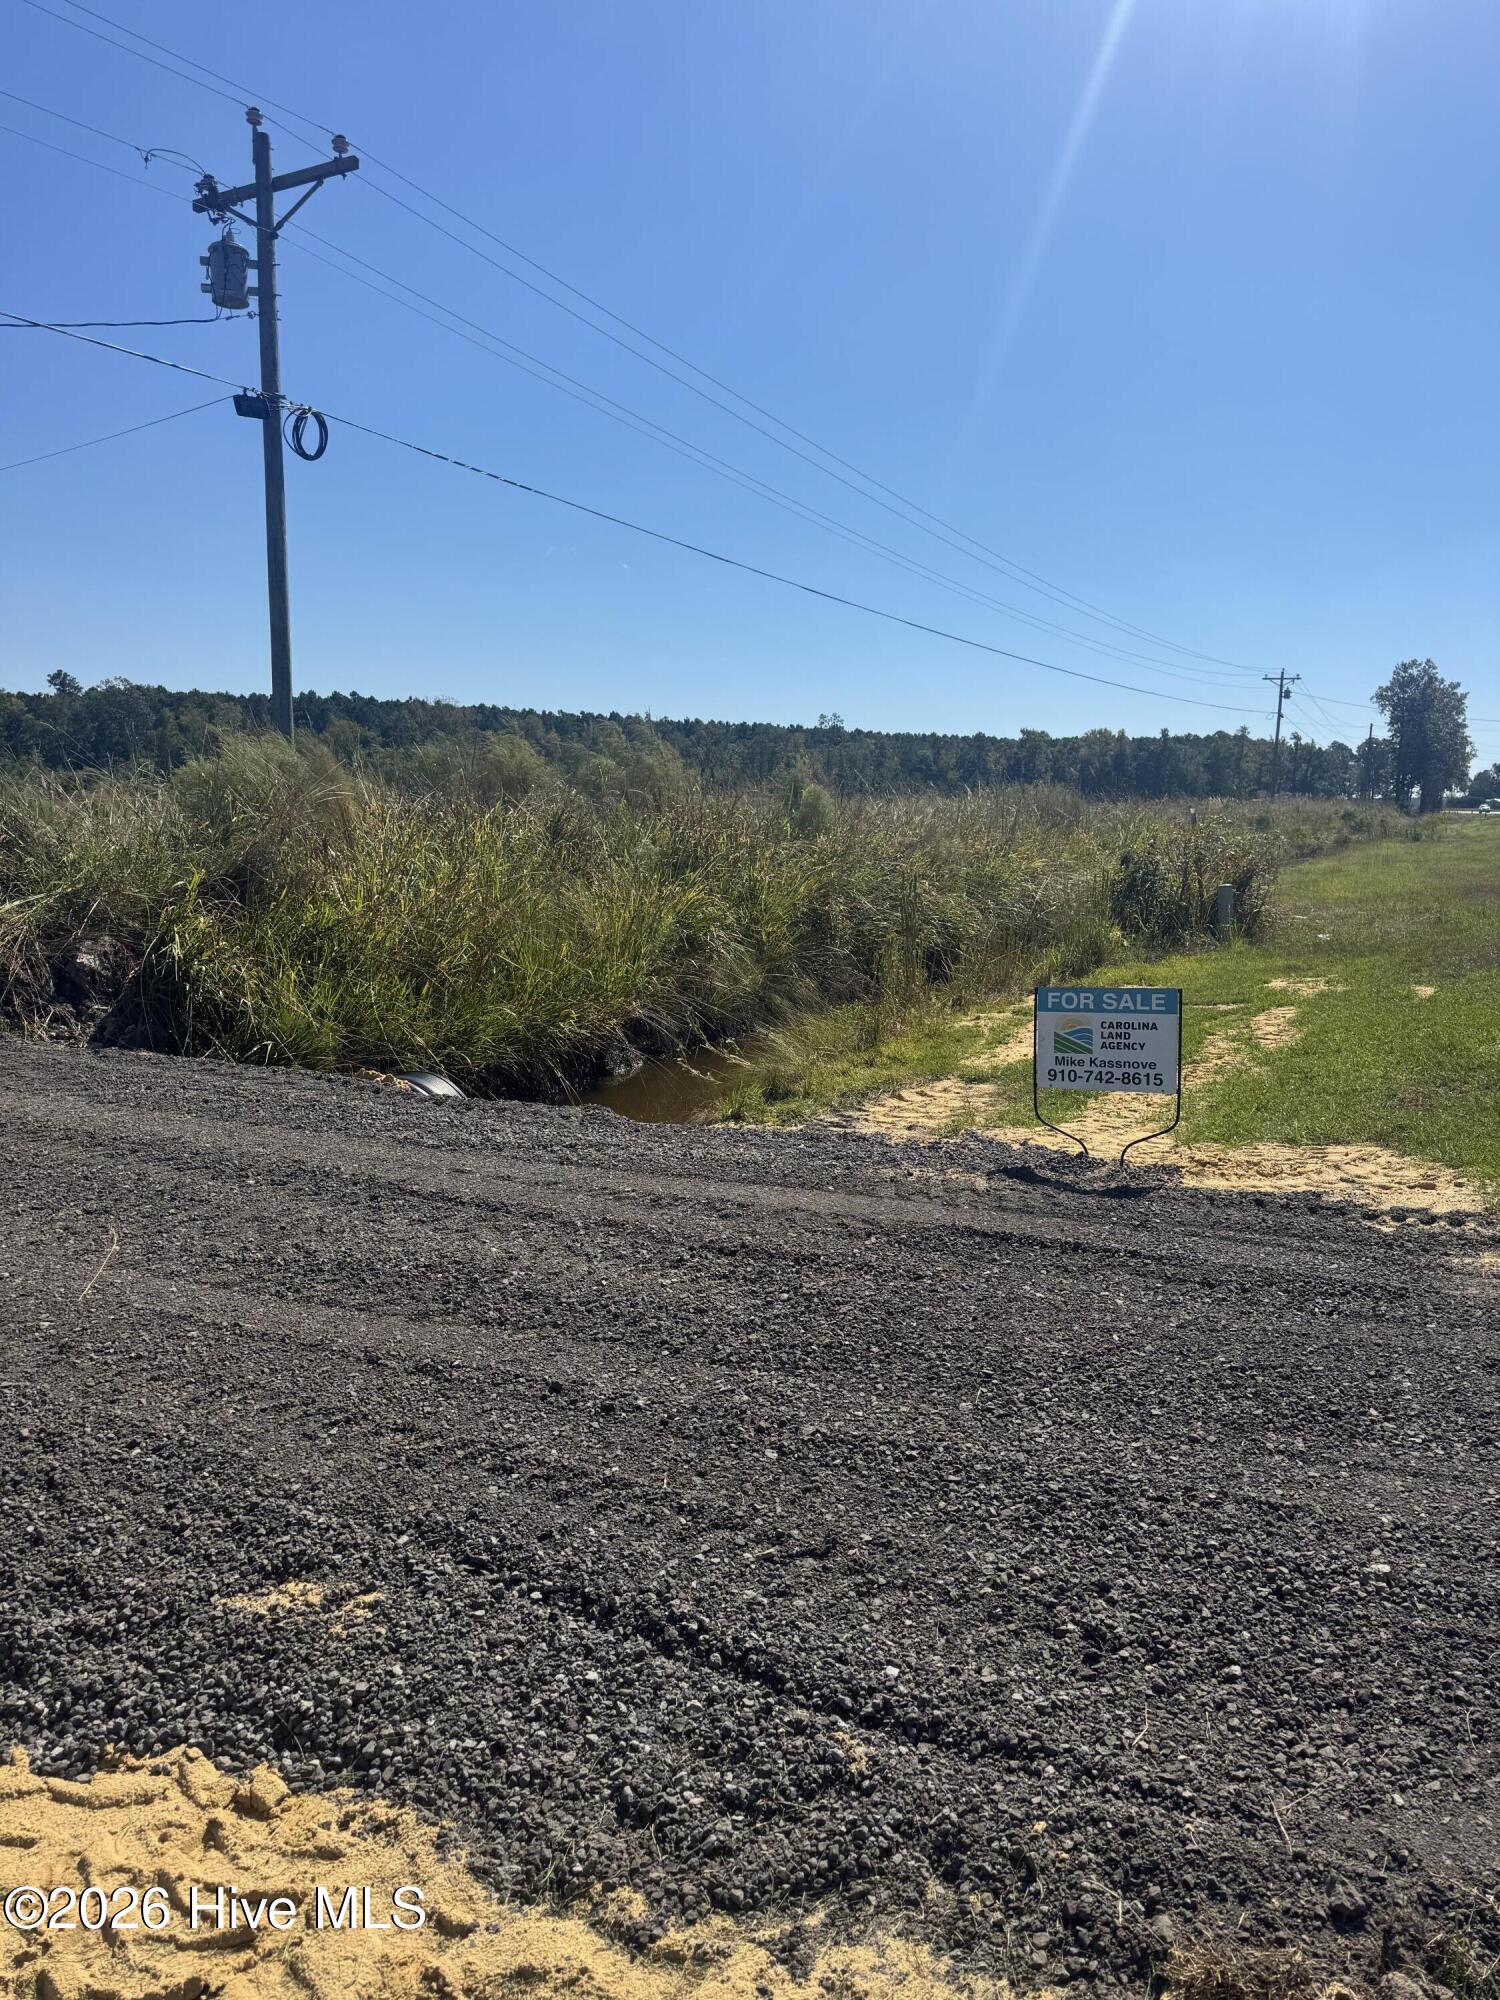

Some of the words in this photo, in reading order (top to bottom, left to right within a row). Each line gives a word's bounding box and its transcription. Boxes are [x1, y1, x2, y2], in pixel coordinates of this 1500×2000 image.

[1047, 992, 1094, 1009] FOR
[1102, 993, 1166, 1011] SALE
[1100, 1021, 1158, 1031] CAROLINA
[1100, 1031, 1131, 1040] LAND
[1100, 1041, 1146, 1051] AGENCY
[1054, 1056, 1085, 1067] Mike
[1089, 1057, 1157, 1070] Kassnove
[1047, 1068, 1164, 1087] 910-742-8615
